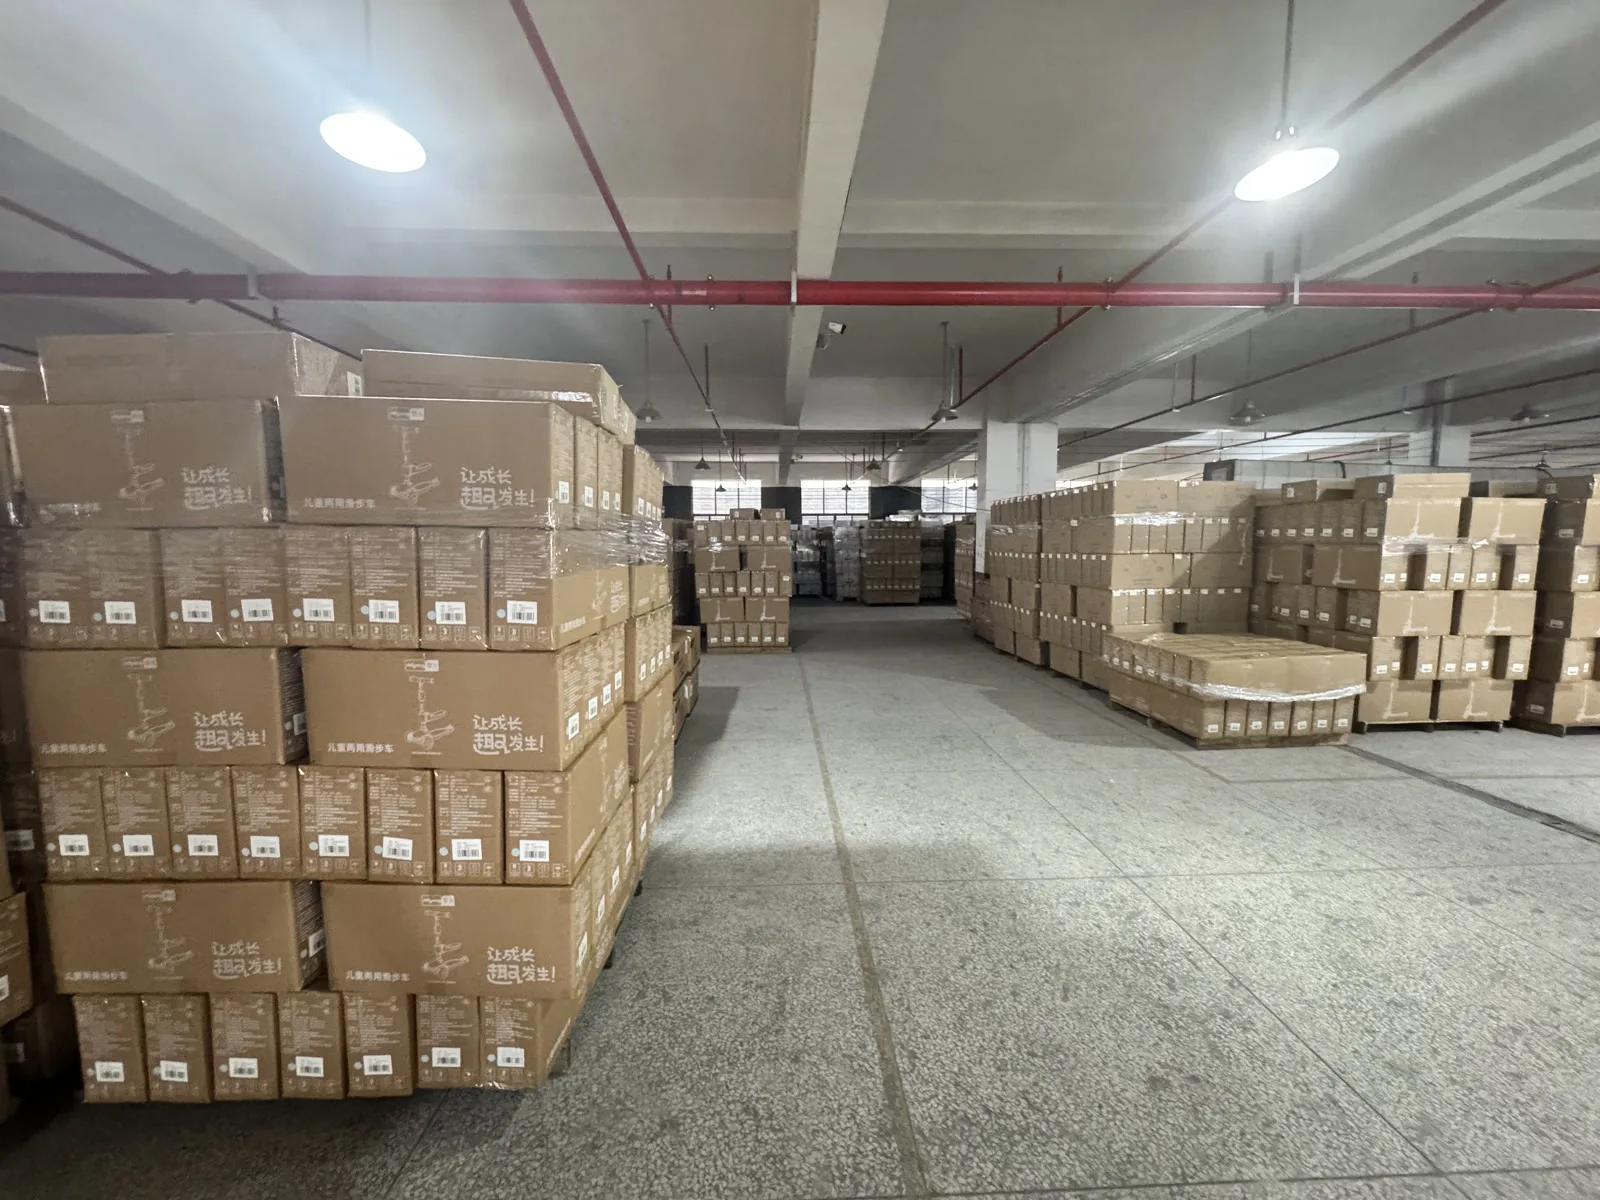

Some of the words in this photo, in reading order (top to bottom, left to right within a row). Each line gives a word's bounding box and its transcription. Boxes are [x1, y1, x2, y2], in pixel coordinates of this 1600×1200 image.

[460, 465, 512, 484] 让成长
[193, 710, 244, 726] 让成长
[472, 714, 522, 731] 让成长
[487, 946, 535, 961] 让成长
